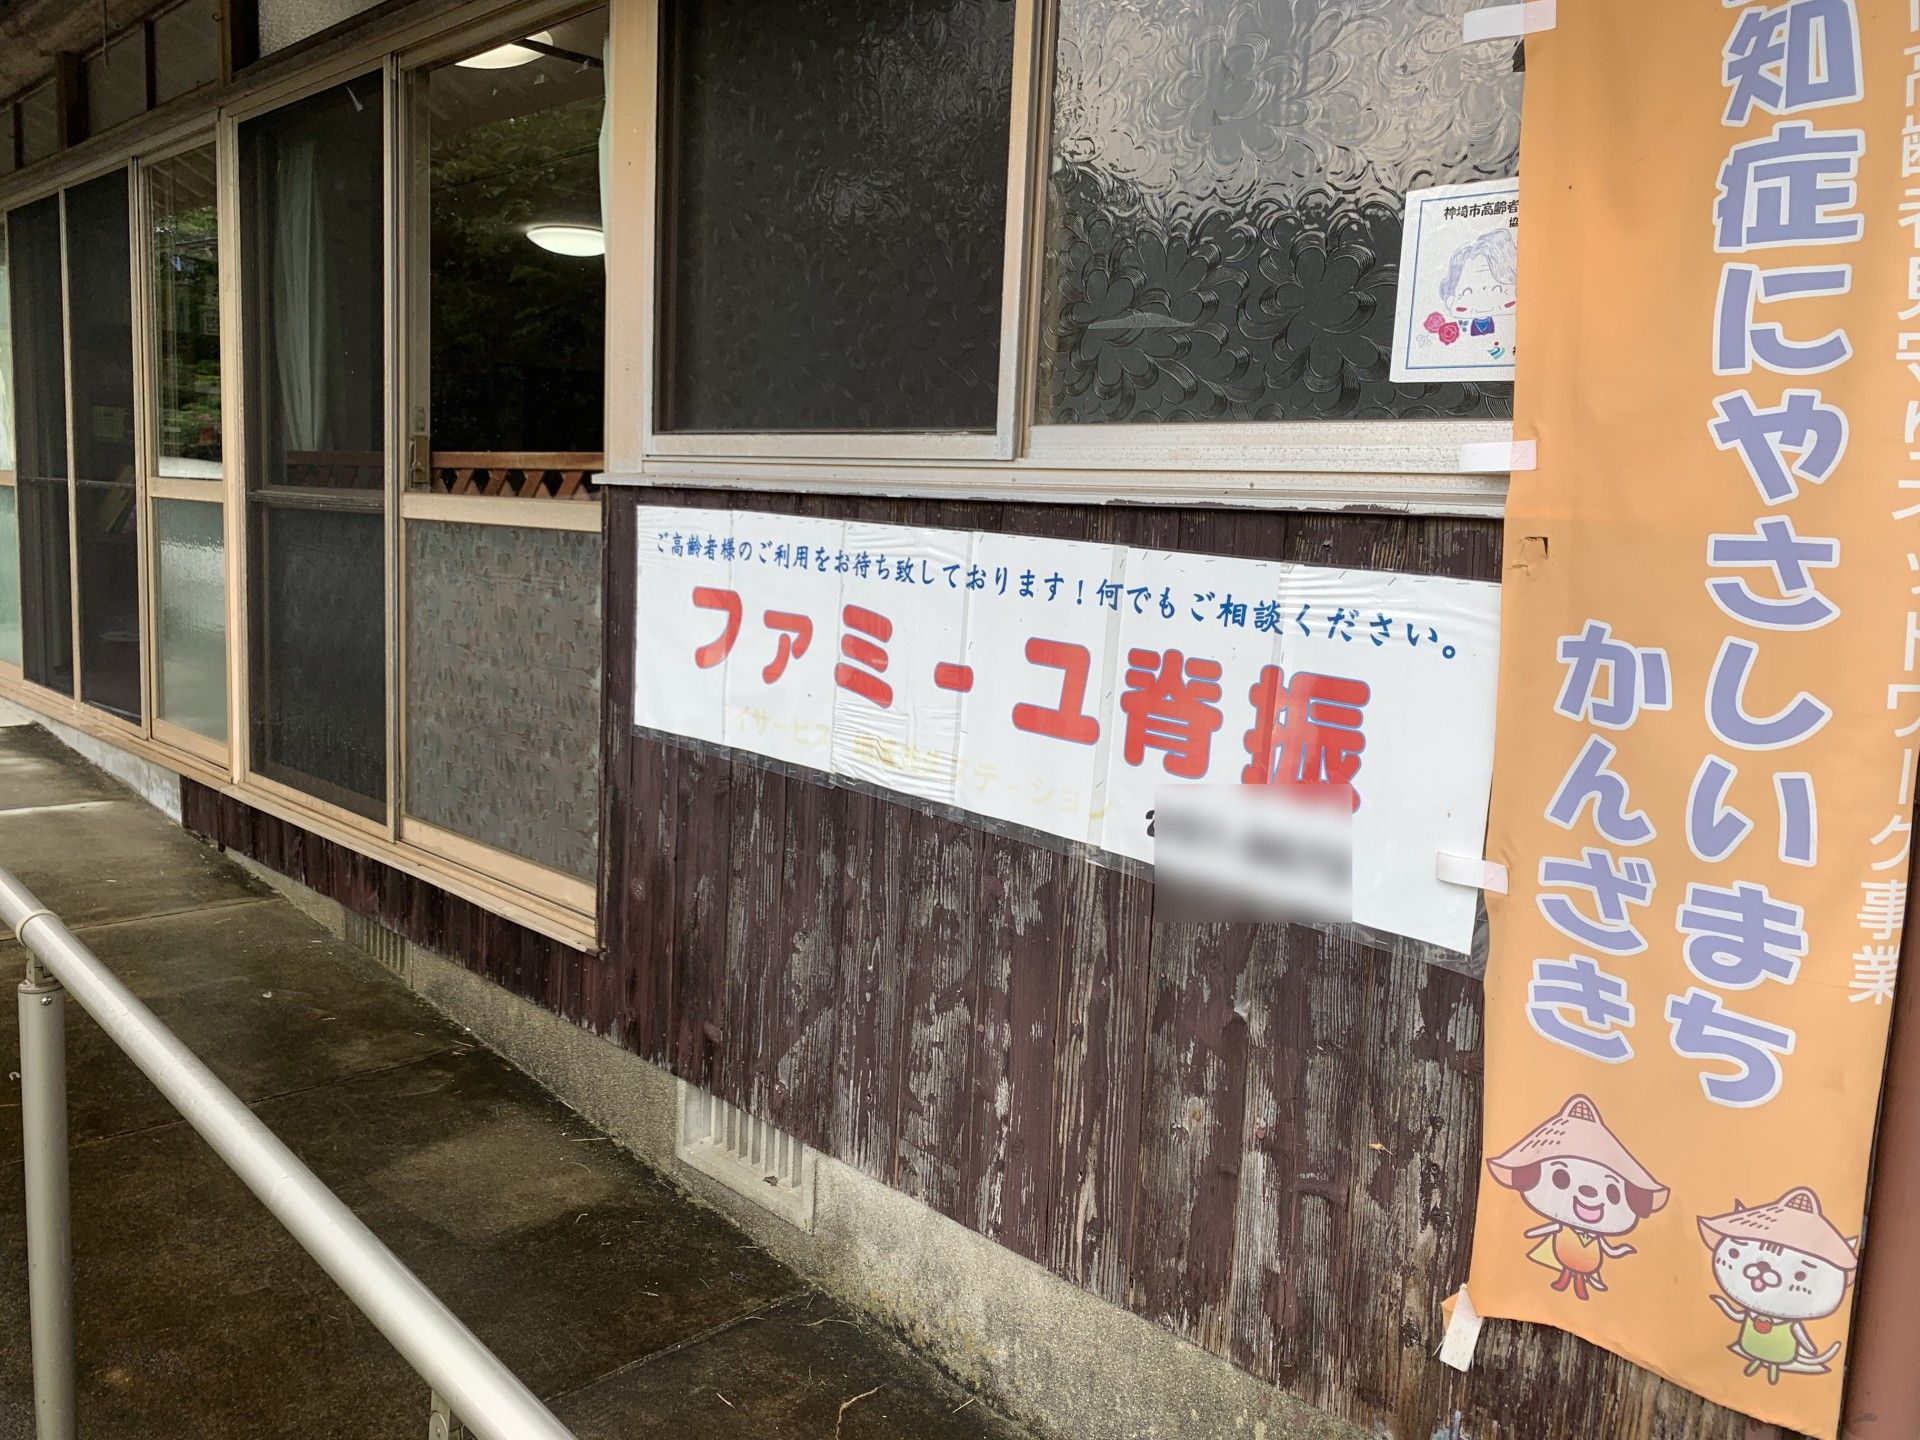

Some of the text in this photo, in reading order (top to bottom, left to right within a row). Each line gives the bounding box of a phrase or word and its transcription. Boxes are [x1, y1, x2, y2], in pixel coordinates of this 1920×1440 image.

[1526, 618, 1672, 1063] かんざき
[1665, 0, 1864, 1108] 知症にやさしいまち
